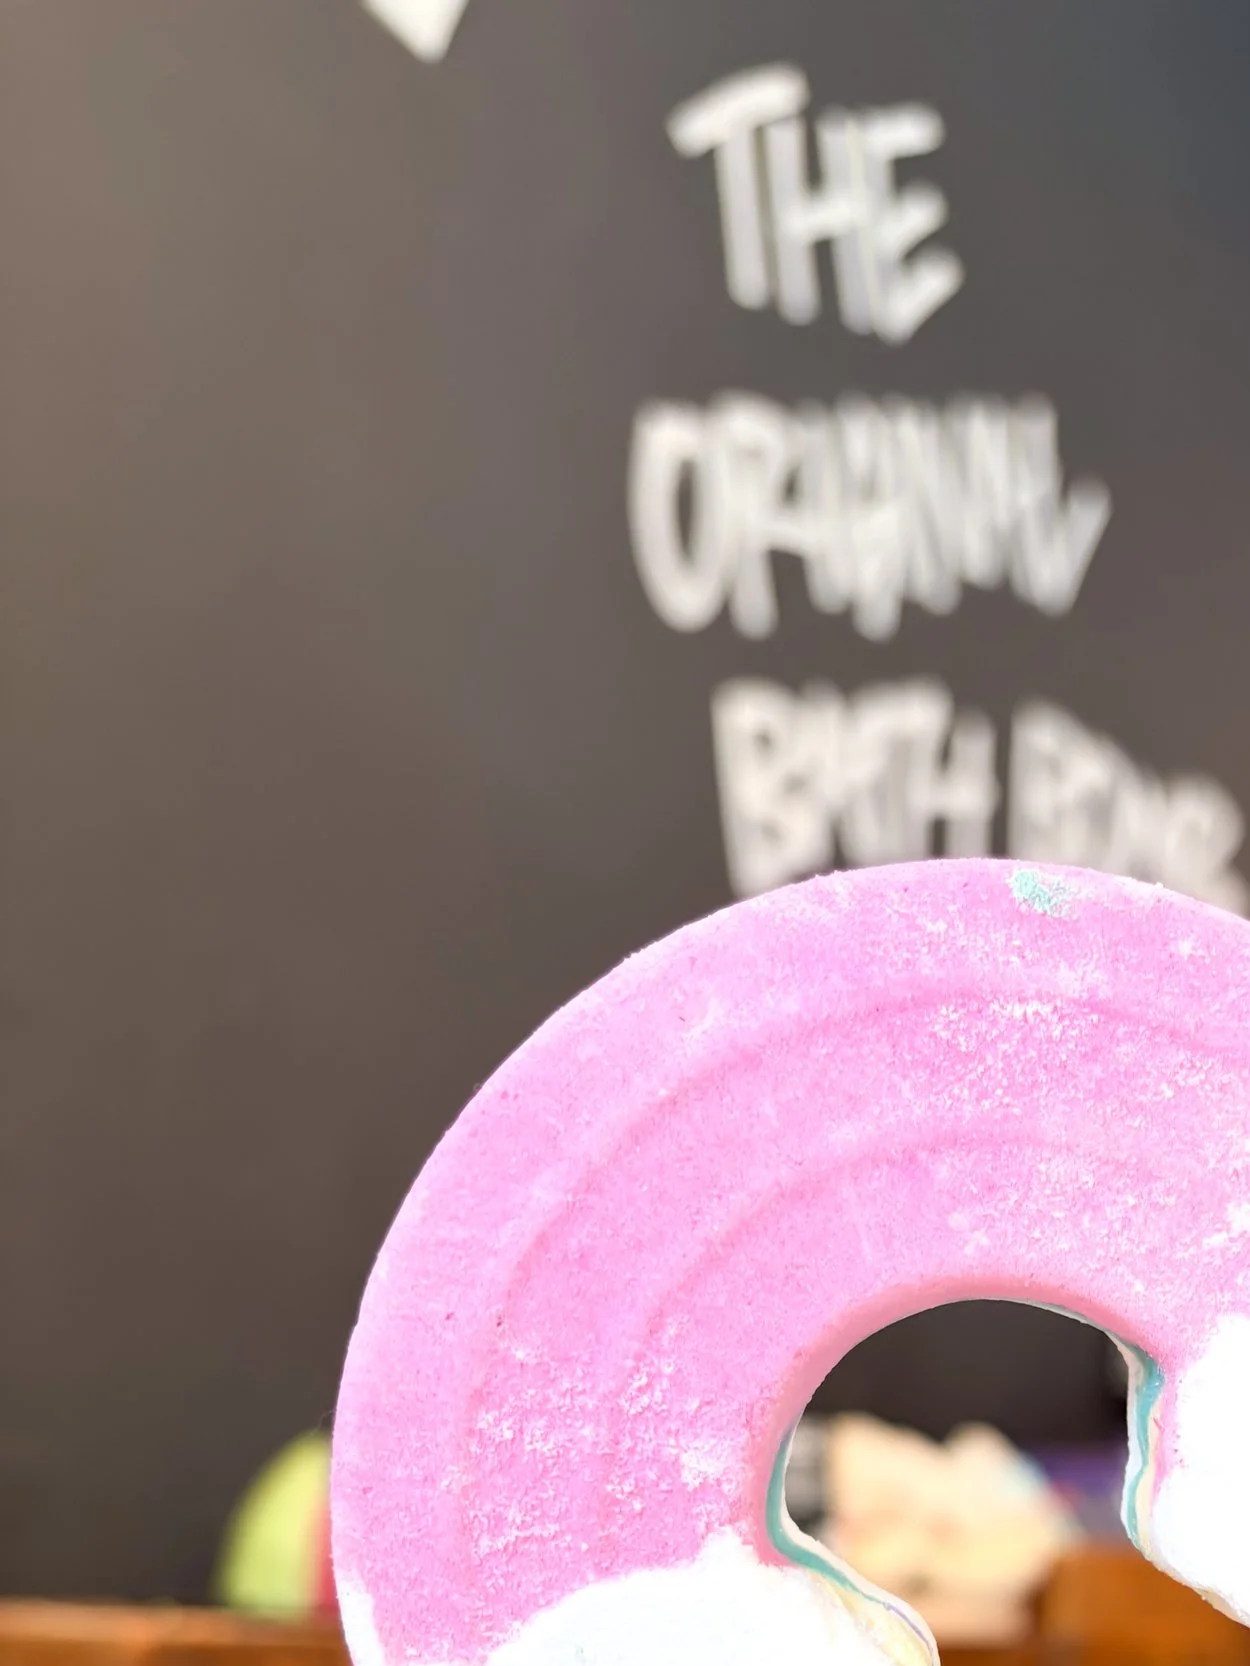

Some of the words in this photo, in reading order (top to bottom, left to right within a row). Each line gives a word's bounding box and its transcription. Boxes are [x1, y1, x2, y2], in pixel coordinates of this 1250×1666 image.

[668, 64, 964, 342] THE
[628, 392, 1110, 640] ORIGINAL
[711, 680, 998, 900] BATH
